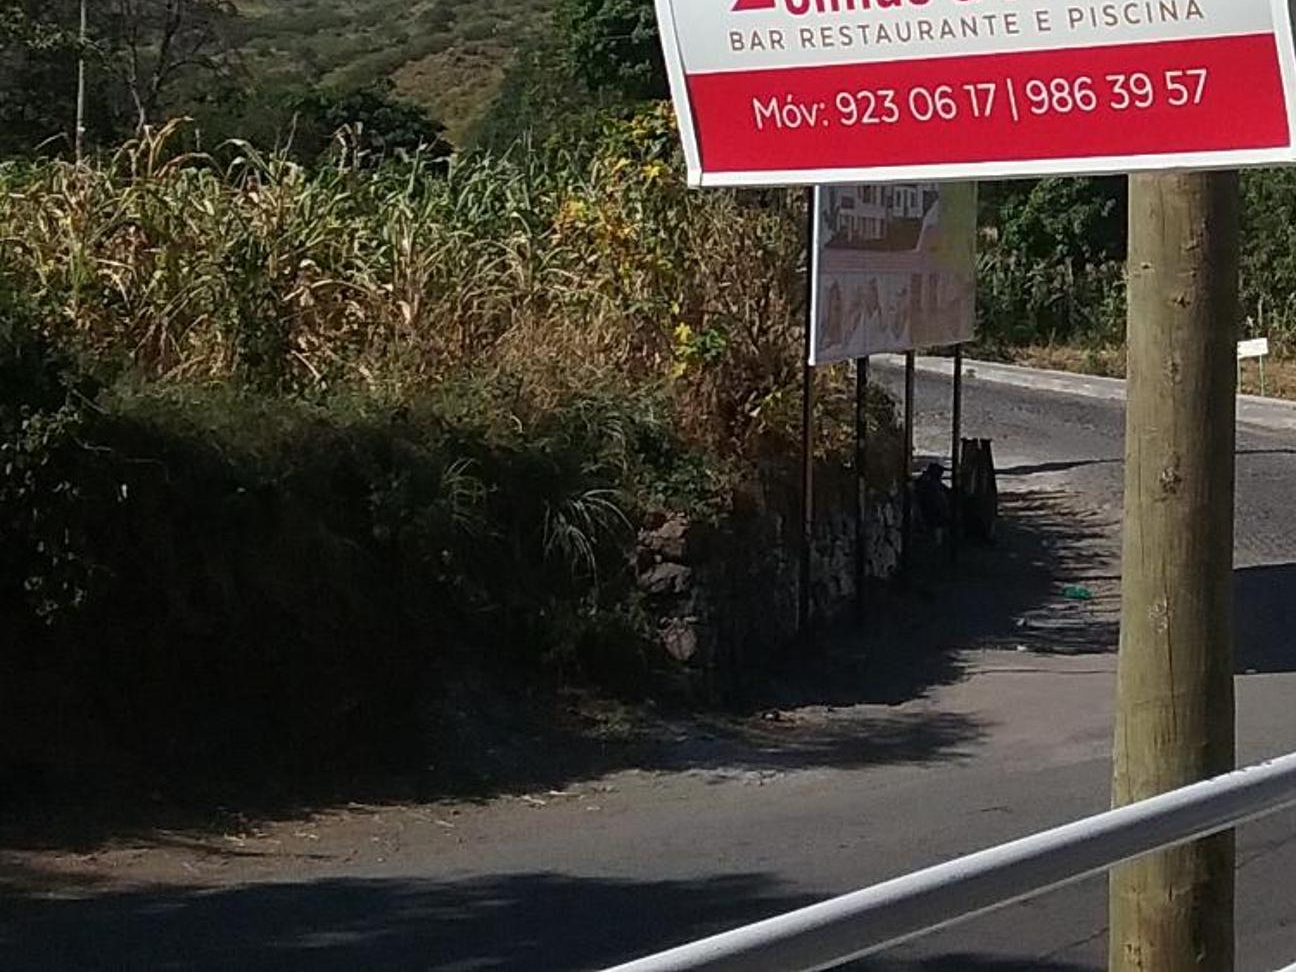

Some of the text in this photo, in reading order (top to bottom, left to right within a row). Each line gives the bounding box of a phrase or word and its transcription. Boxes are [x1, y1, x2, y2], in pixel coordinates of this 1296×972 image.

[729, 29, 786, 52] BAR
[800, 12, 1020, 49] RESTAURANTE
[1036, 10, 1052, 32] E
[751, 93, 830, 129] Móv:
[835, 89, 900, 126] 923
[907, 84, 958, 122] 06
[962, 82, 998, 118] 17
[1024, 76, 1098, 115] 986
[1105, 72, 1155, 110] 39
[1163, 67, 1209, 107] 57
